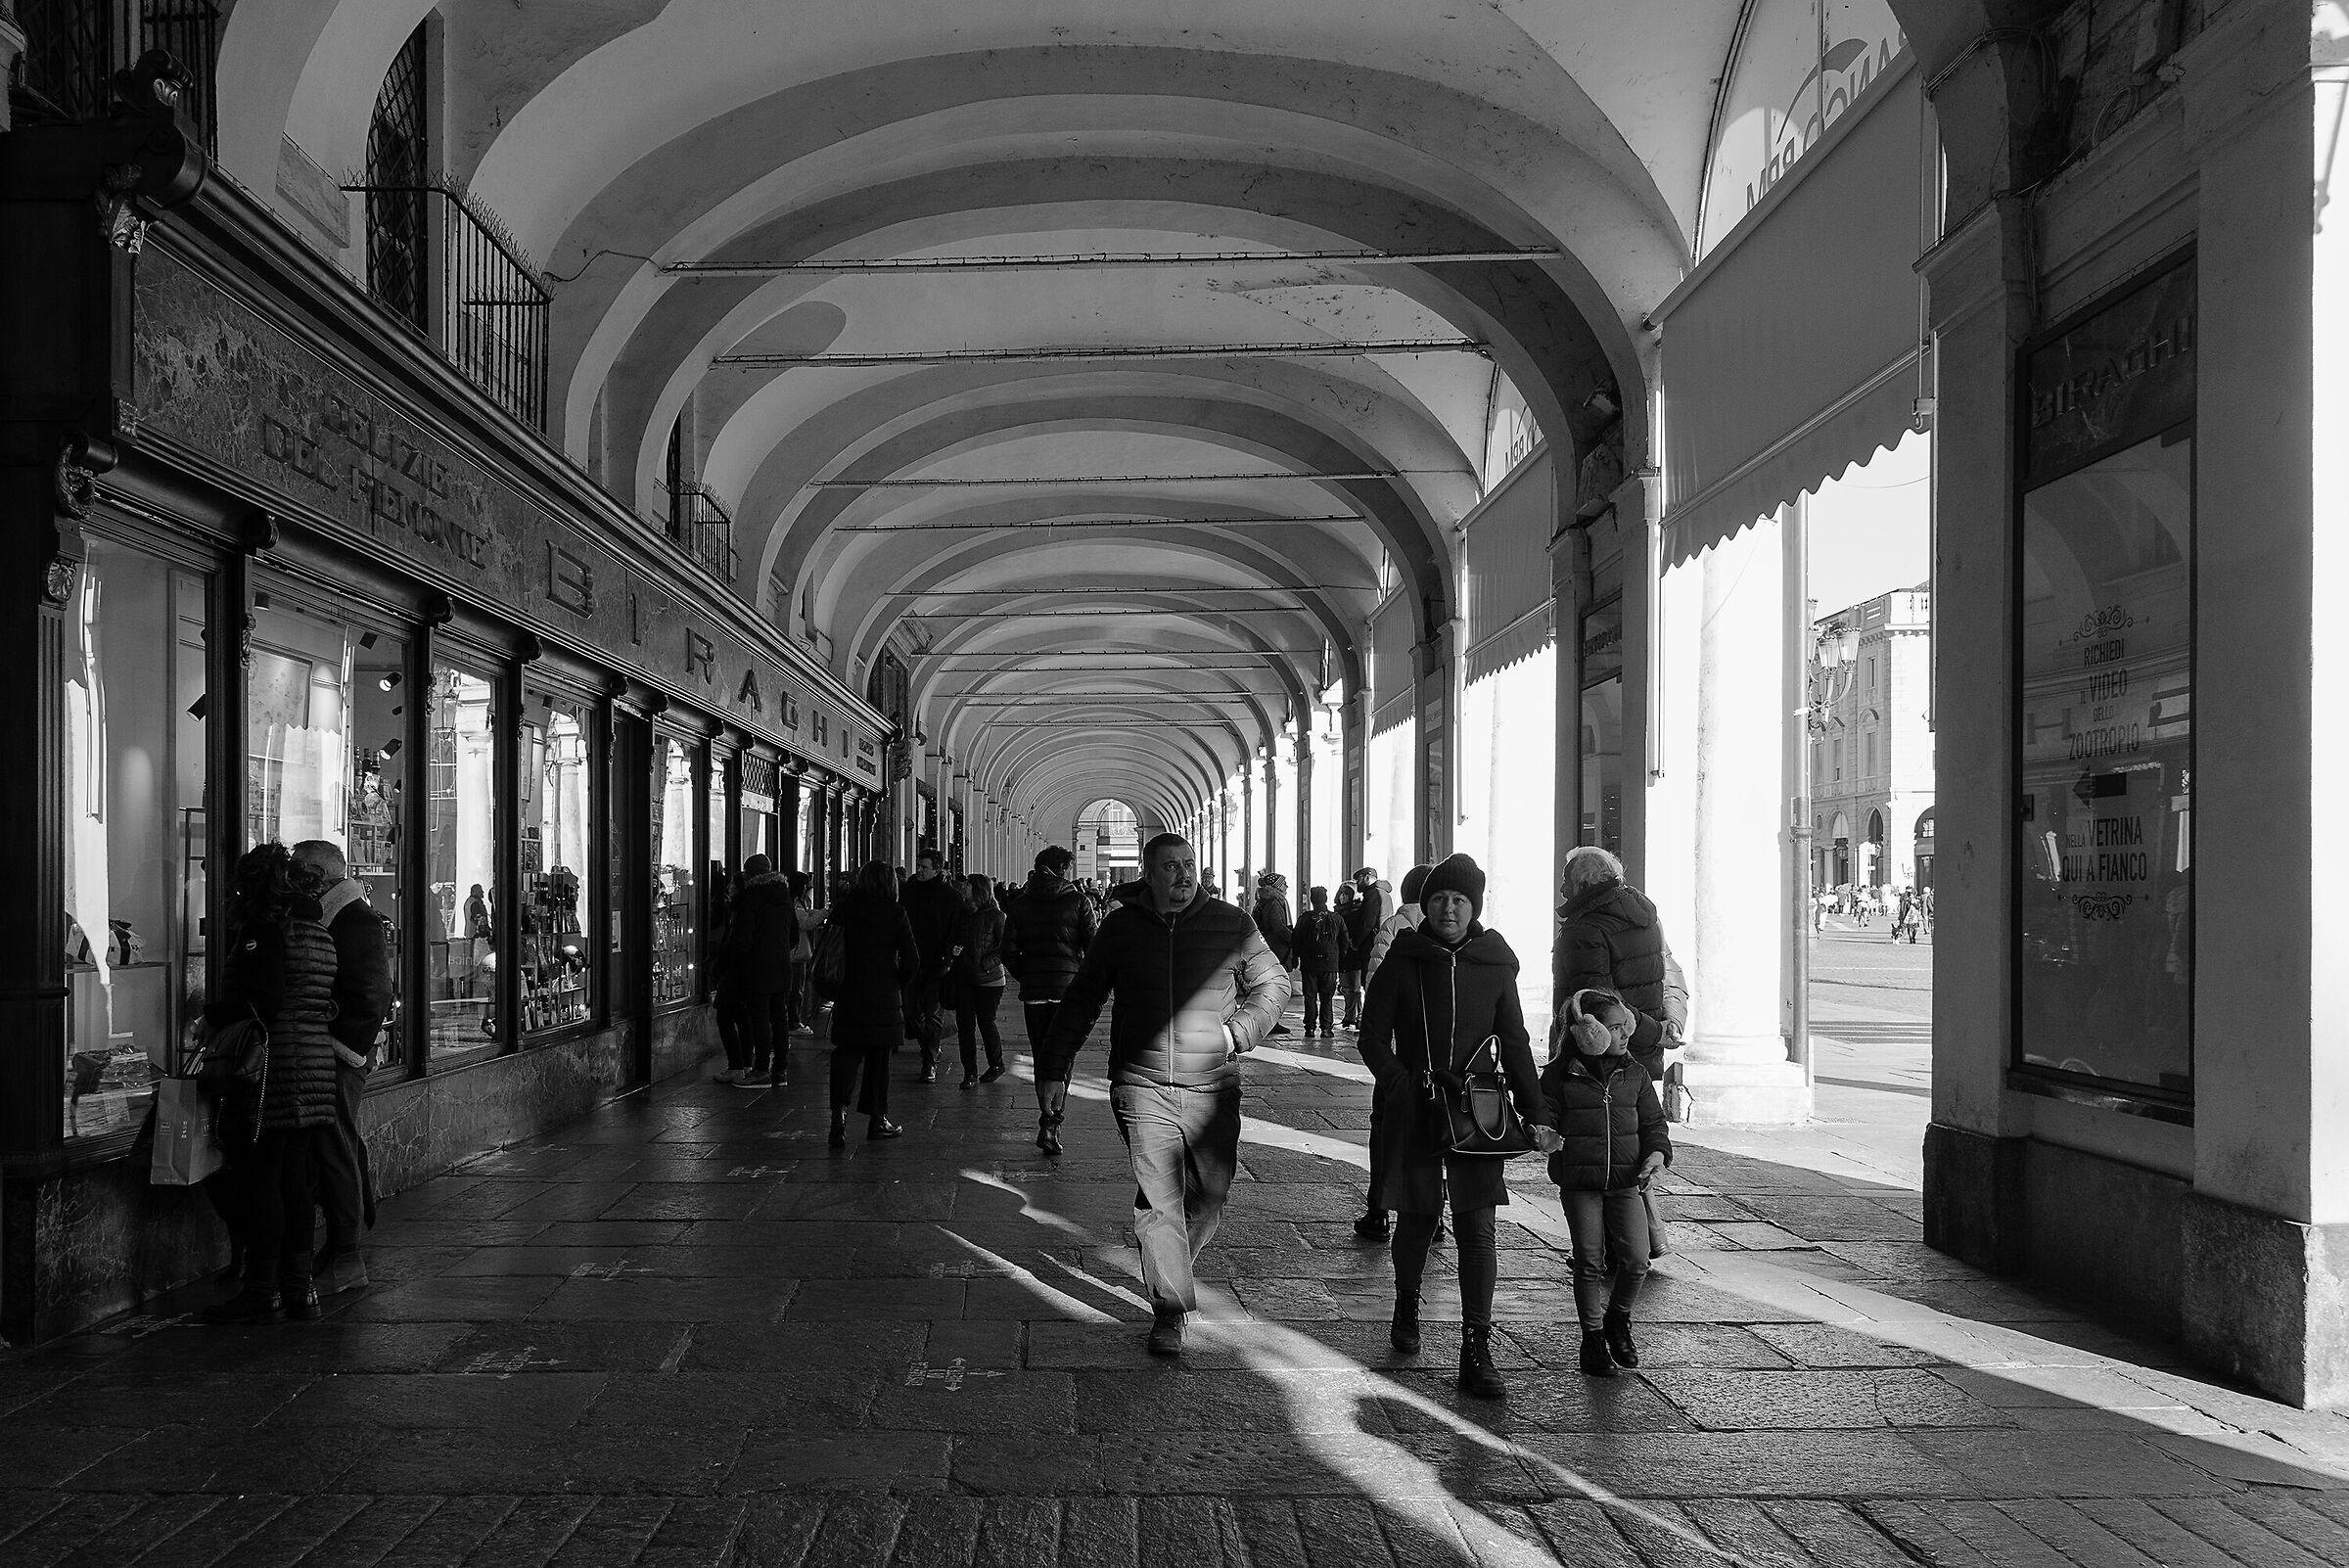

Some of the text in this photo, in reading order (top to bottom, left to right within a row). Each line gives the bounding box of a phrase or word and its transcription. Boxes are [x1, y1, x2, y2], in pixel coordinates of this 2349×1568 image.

[2029, 311, 2194, 430] BIRAGHI
[322, 392, 449, 500] DELIZIE
[260, 415, 486, 570] DEL PIEMONTE
[545, 539, 850, 759] BIRAGHI
[2083, 638, 2125, 668] RICHIEDI
[2089, 668, 2128, 702] VIDEO
[2068, 722, 2140, 761] ZOOTROPIO
[2065, 814, 2143, 848] NELLA VETRINA
[2061, 852, 2147, 882] QUI A FIANCO
